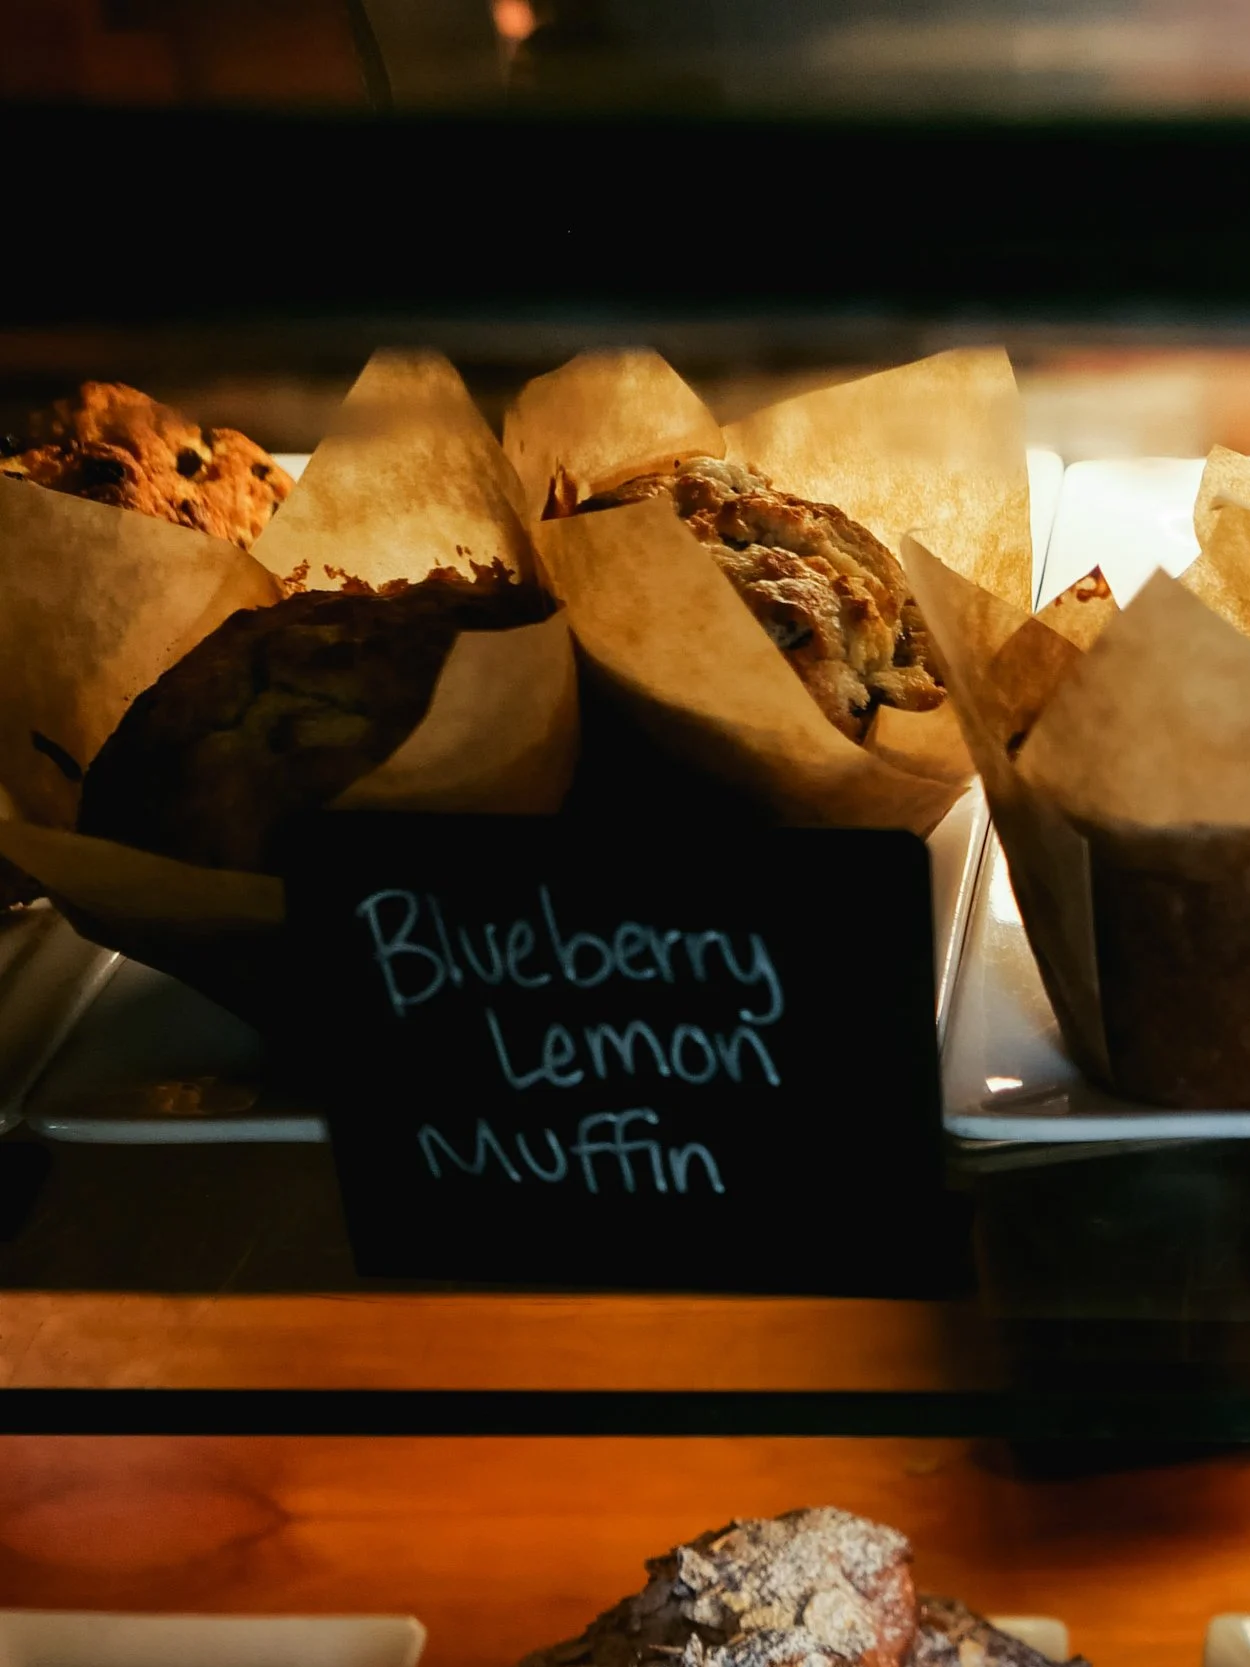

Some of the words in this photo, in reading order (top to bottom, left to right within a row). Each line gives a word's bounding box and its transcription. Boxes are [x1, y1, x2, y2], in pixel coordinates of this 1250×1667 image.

[355, 883, 786, 1027] Blueberry
[484, 1006, 783, 1090] Lemon
[417, 1106, 727, 1194] Muffin
